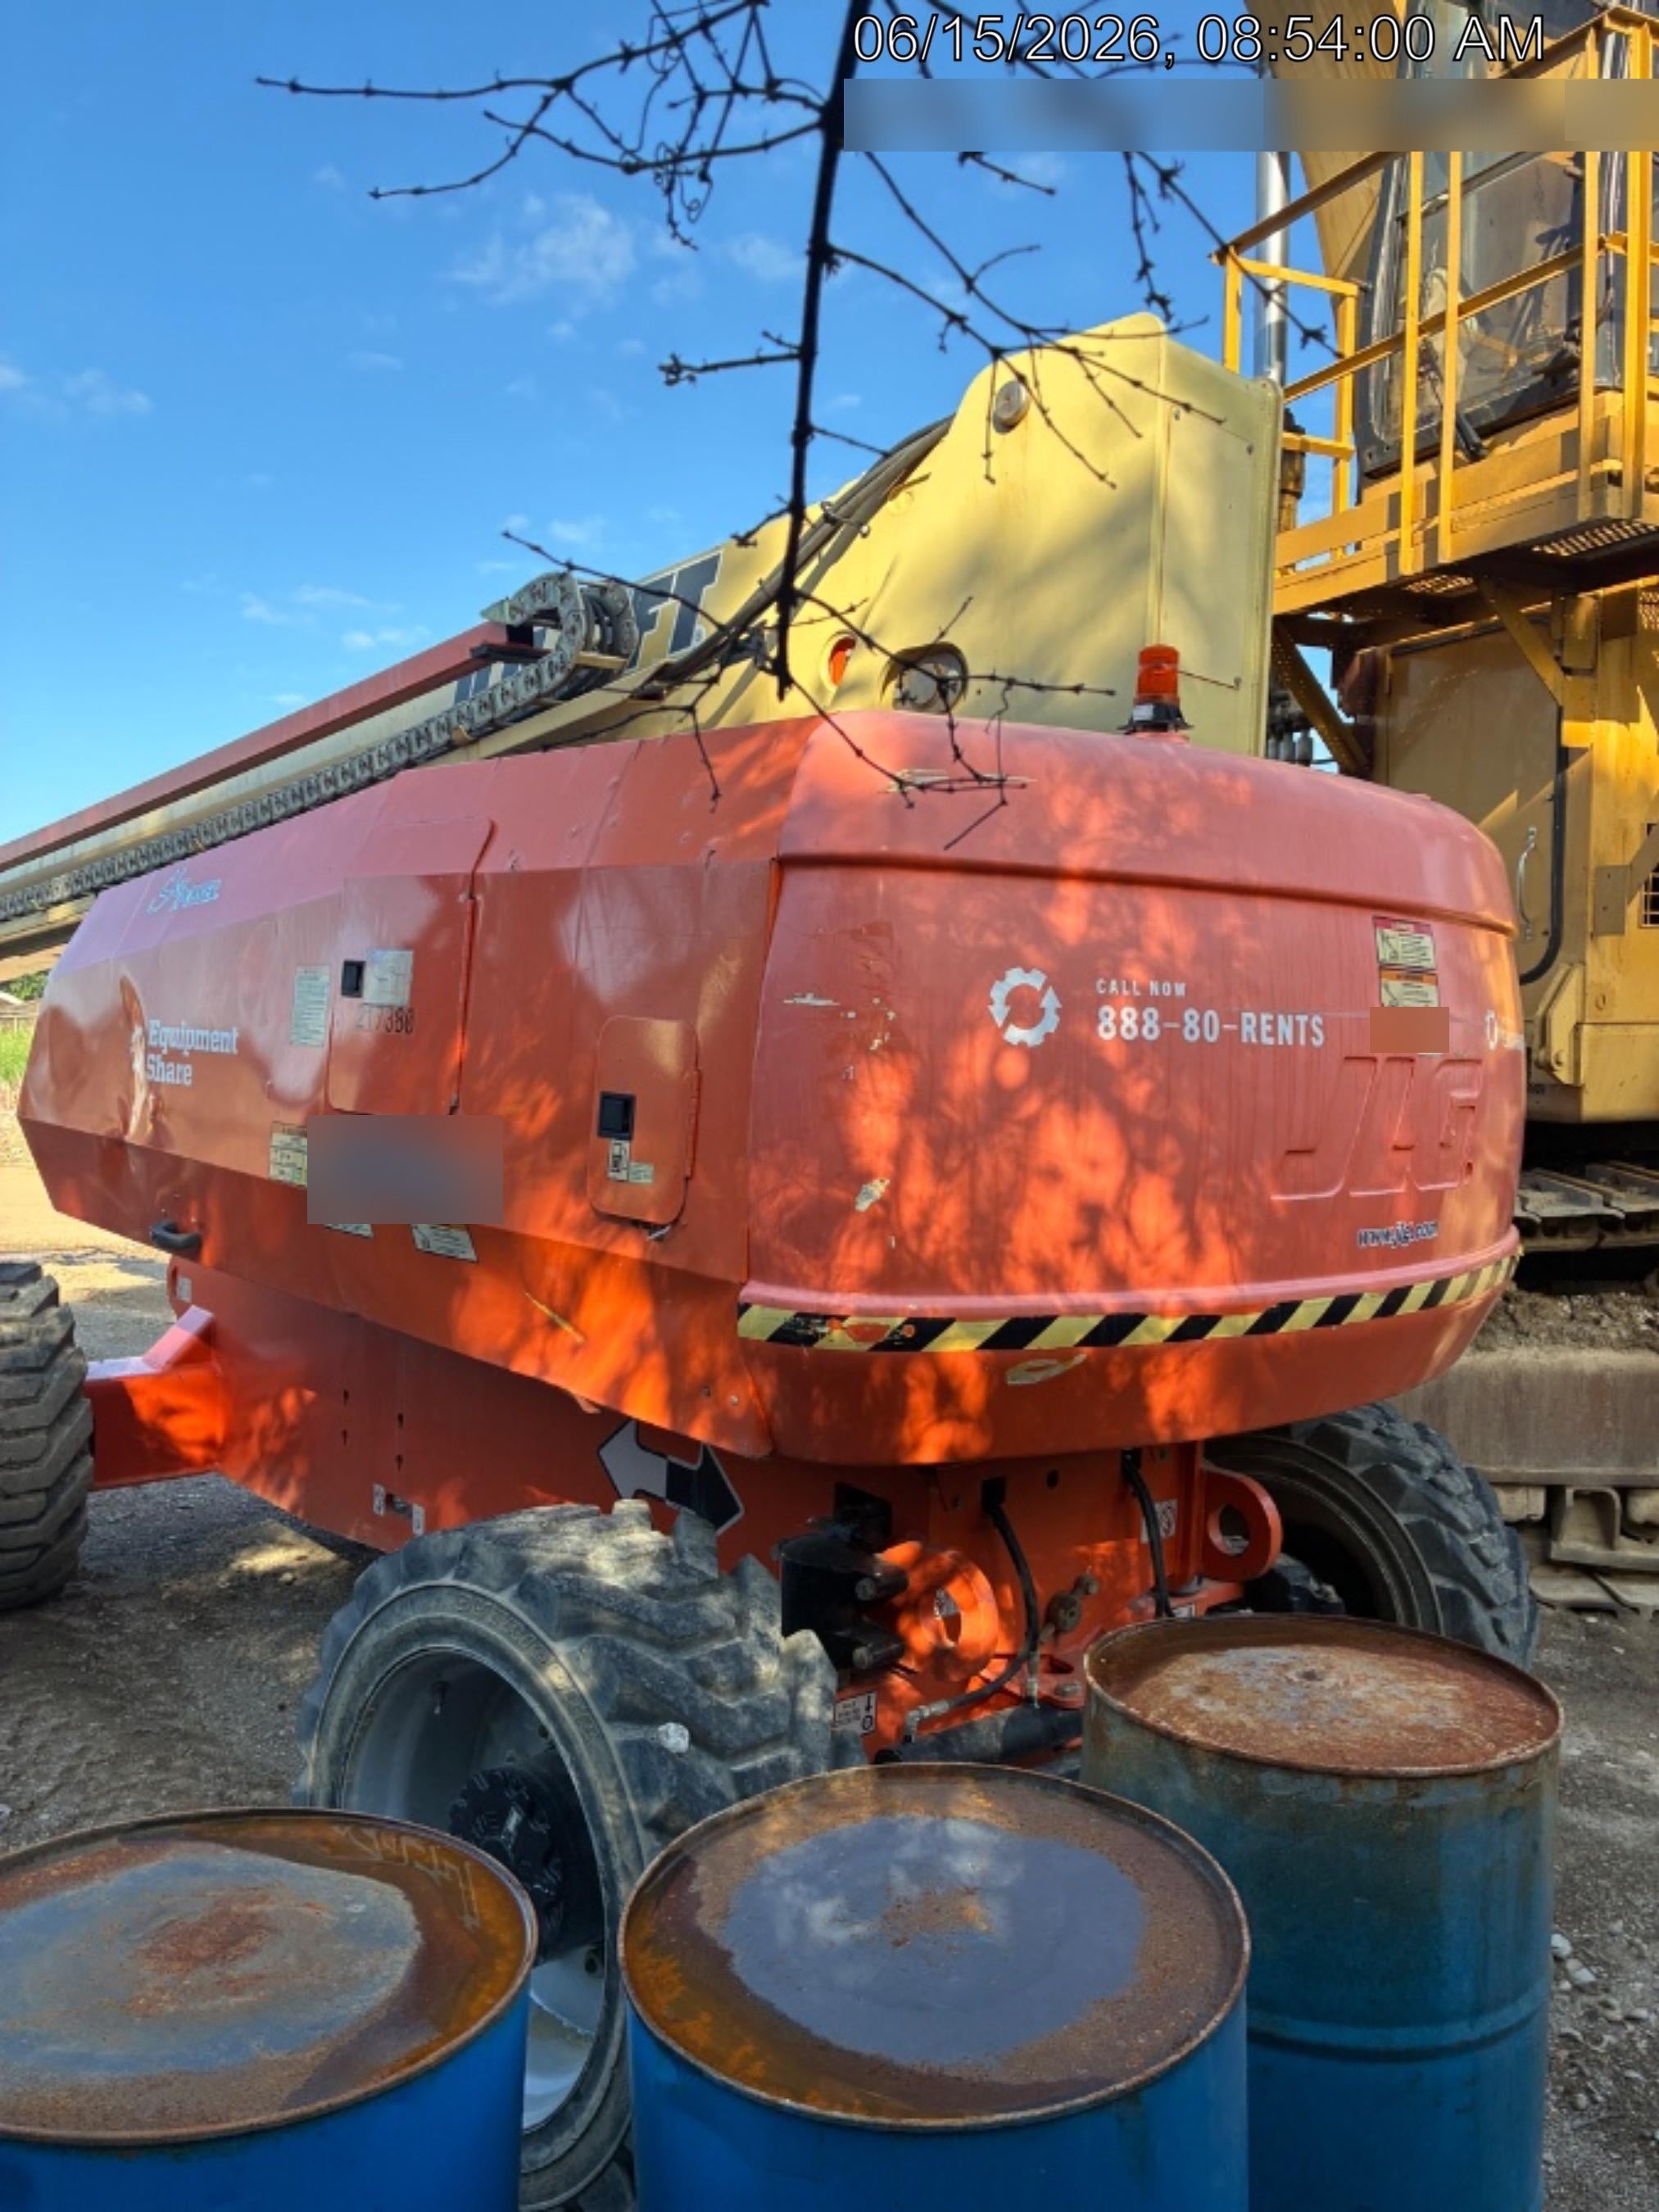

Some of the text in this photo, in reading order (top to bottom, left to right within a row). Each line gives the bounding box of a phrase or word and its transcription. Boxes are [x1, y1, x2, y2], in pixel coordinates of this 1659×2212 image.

[1095, 977, 1187, 998] CALL NOW
[148, 1018, 239, 1056] Equipment
[1097, 1004, 1326, 1048] 888-80-RENTS
[146, 1054, 194, 1087] Share
